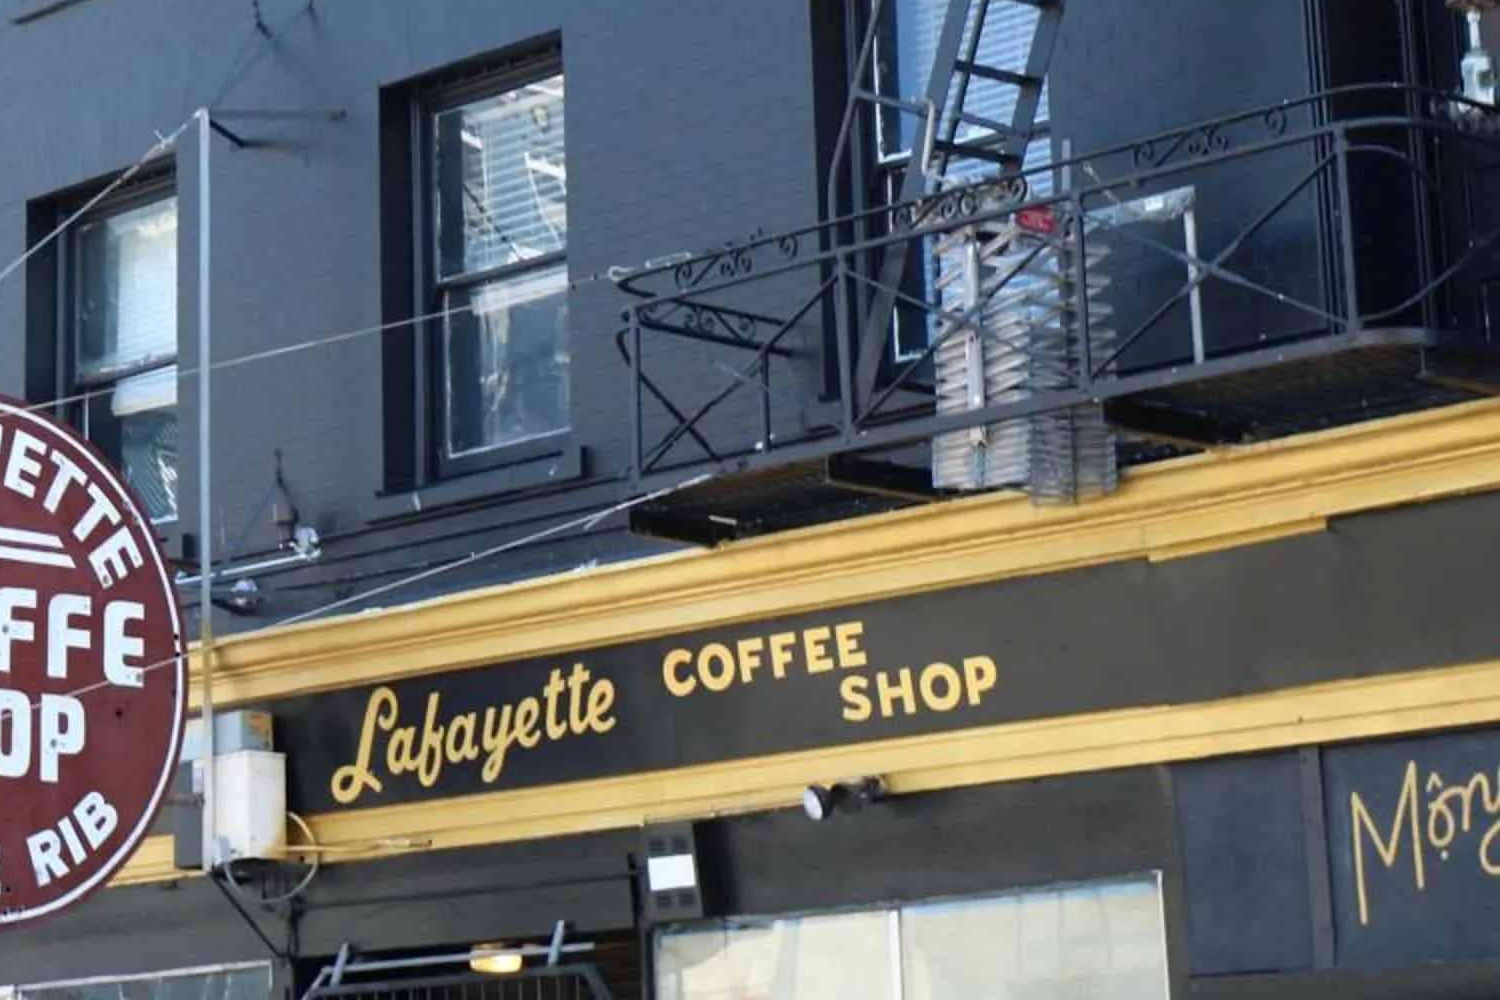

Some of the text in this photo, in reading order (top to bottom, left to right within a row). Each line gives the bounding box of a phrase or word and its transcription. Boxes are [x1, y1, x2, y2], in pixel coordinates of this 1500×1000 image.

[662, 621, 869, 698] COFFEE
[840, 655, 998, 722] SHOP
[330, 661, 617, 804] Lafayette
[26, 791, 120, 887] RIB
